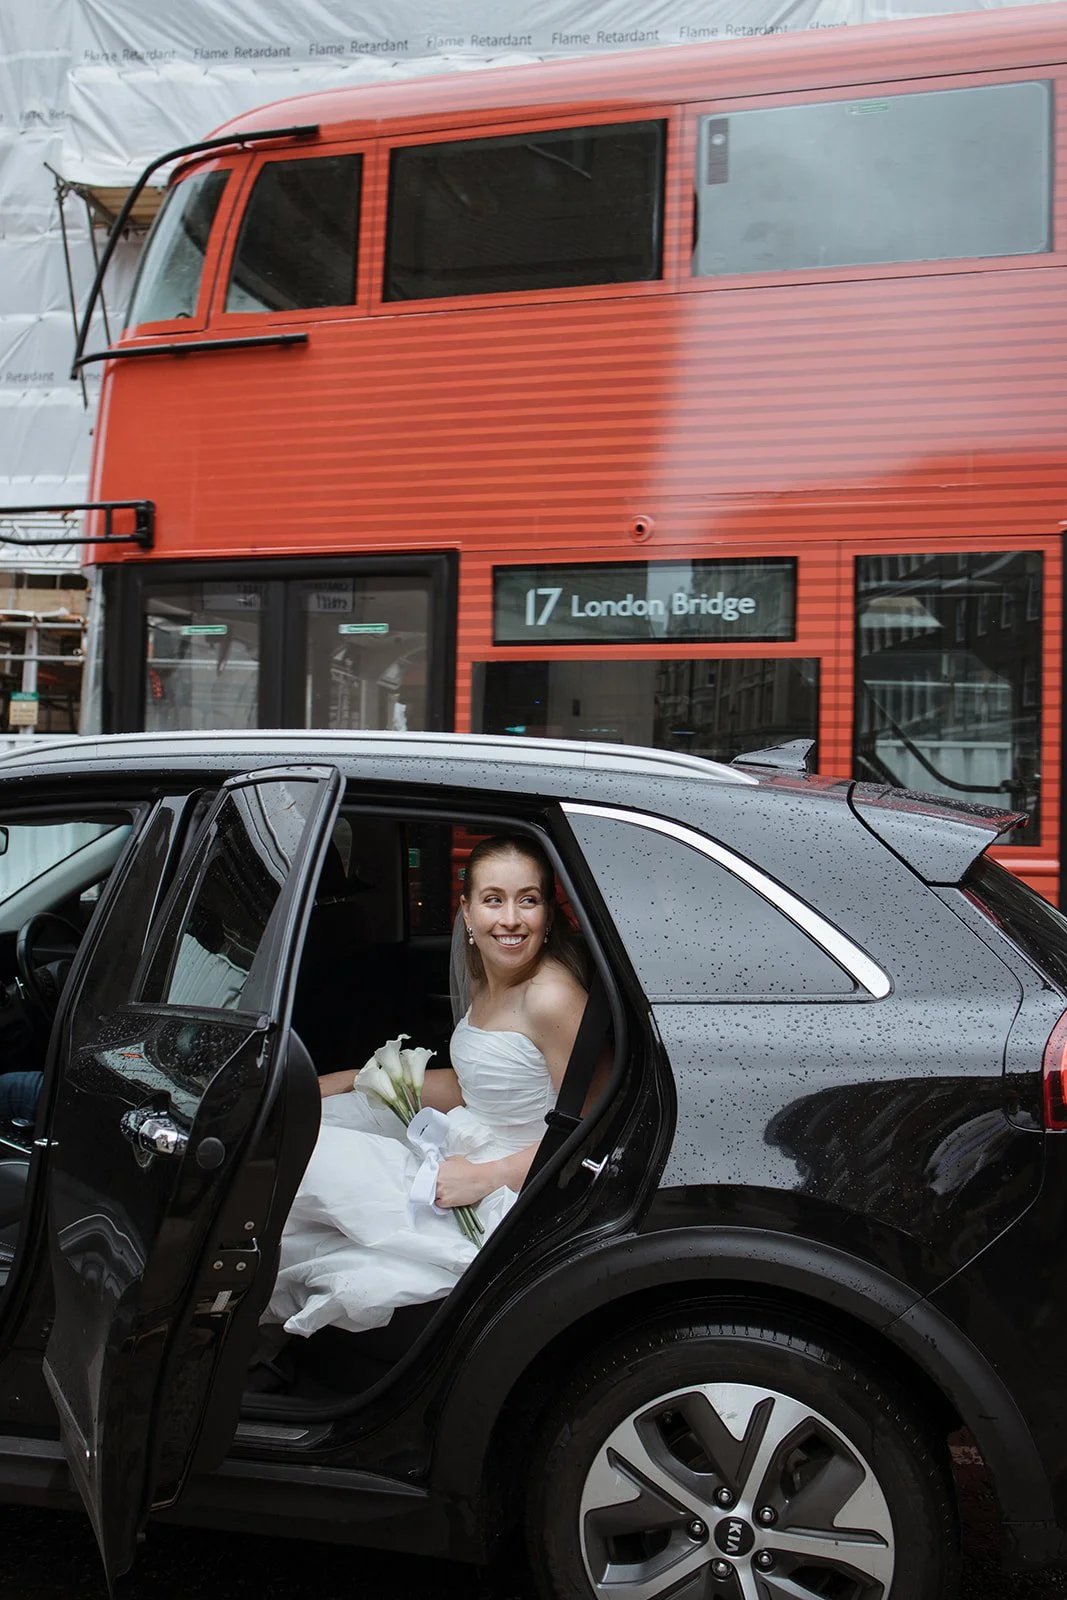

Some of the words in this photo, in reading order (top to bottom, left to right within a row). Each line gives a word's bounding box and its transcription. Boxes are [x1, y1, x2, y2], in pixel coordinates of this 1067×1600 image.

[552, 31, 590, 45] Flame
[596, 28, 659, 44] Retardant
[679, 25, 719, 39] Flame
[725, 22, 788, 37] Retardant
[309, 42, 345, 56] Flame
[350, 39, 409, 54] Retardant
[427, 34, 464, 48] Flame
[470, 33, 532, 47] Retardant
[84, 49, 117, 62] Flame
[122, 48, 176, 61] Retardant
[194, 47, 229, 60] Flame
[234, 45, 291, 59] Retardant
[525, 587, 563, 625] 17
[571, 593, 664, 617] London
[672, 592, 756, 621] Bridge
[726, 1522, 743, 1551] KIA
